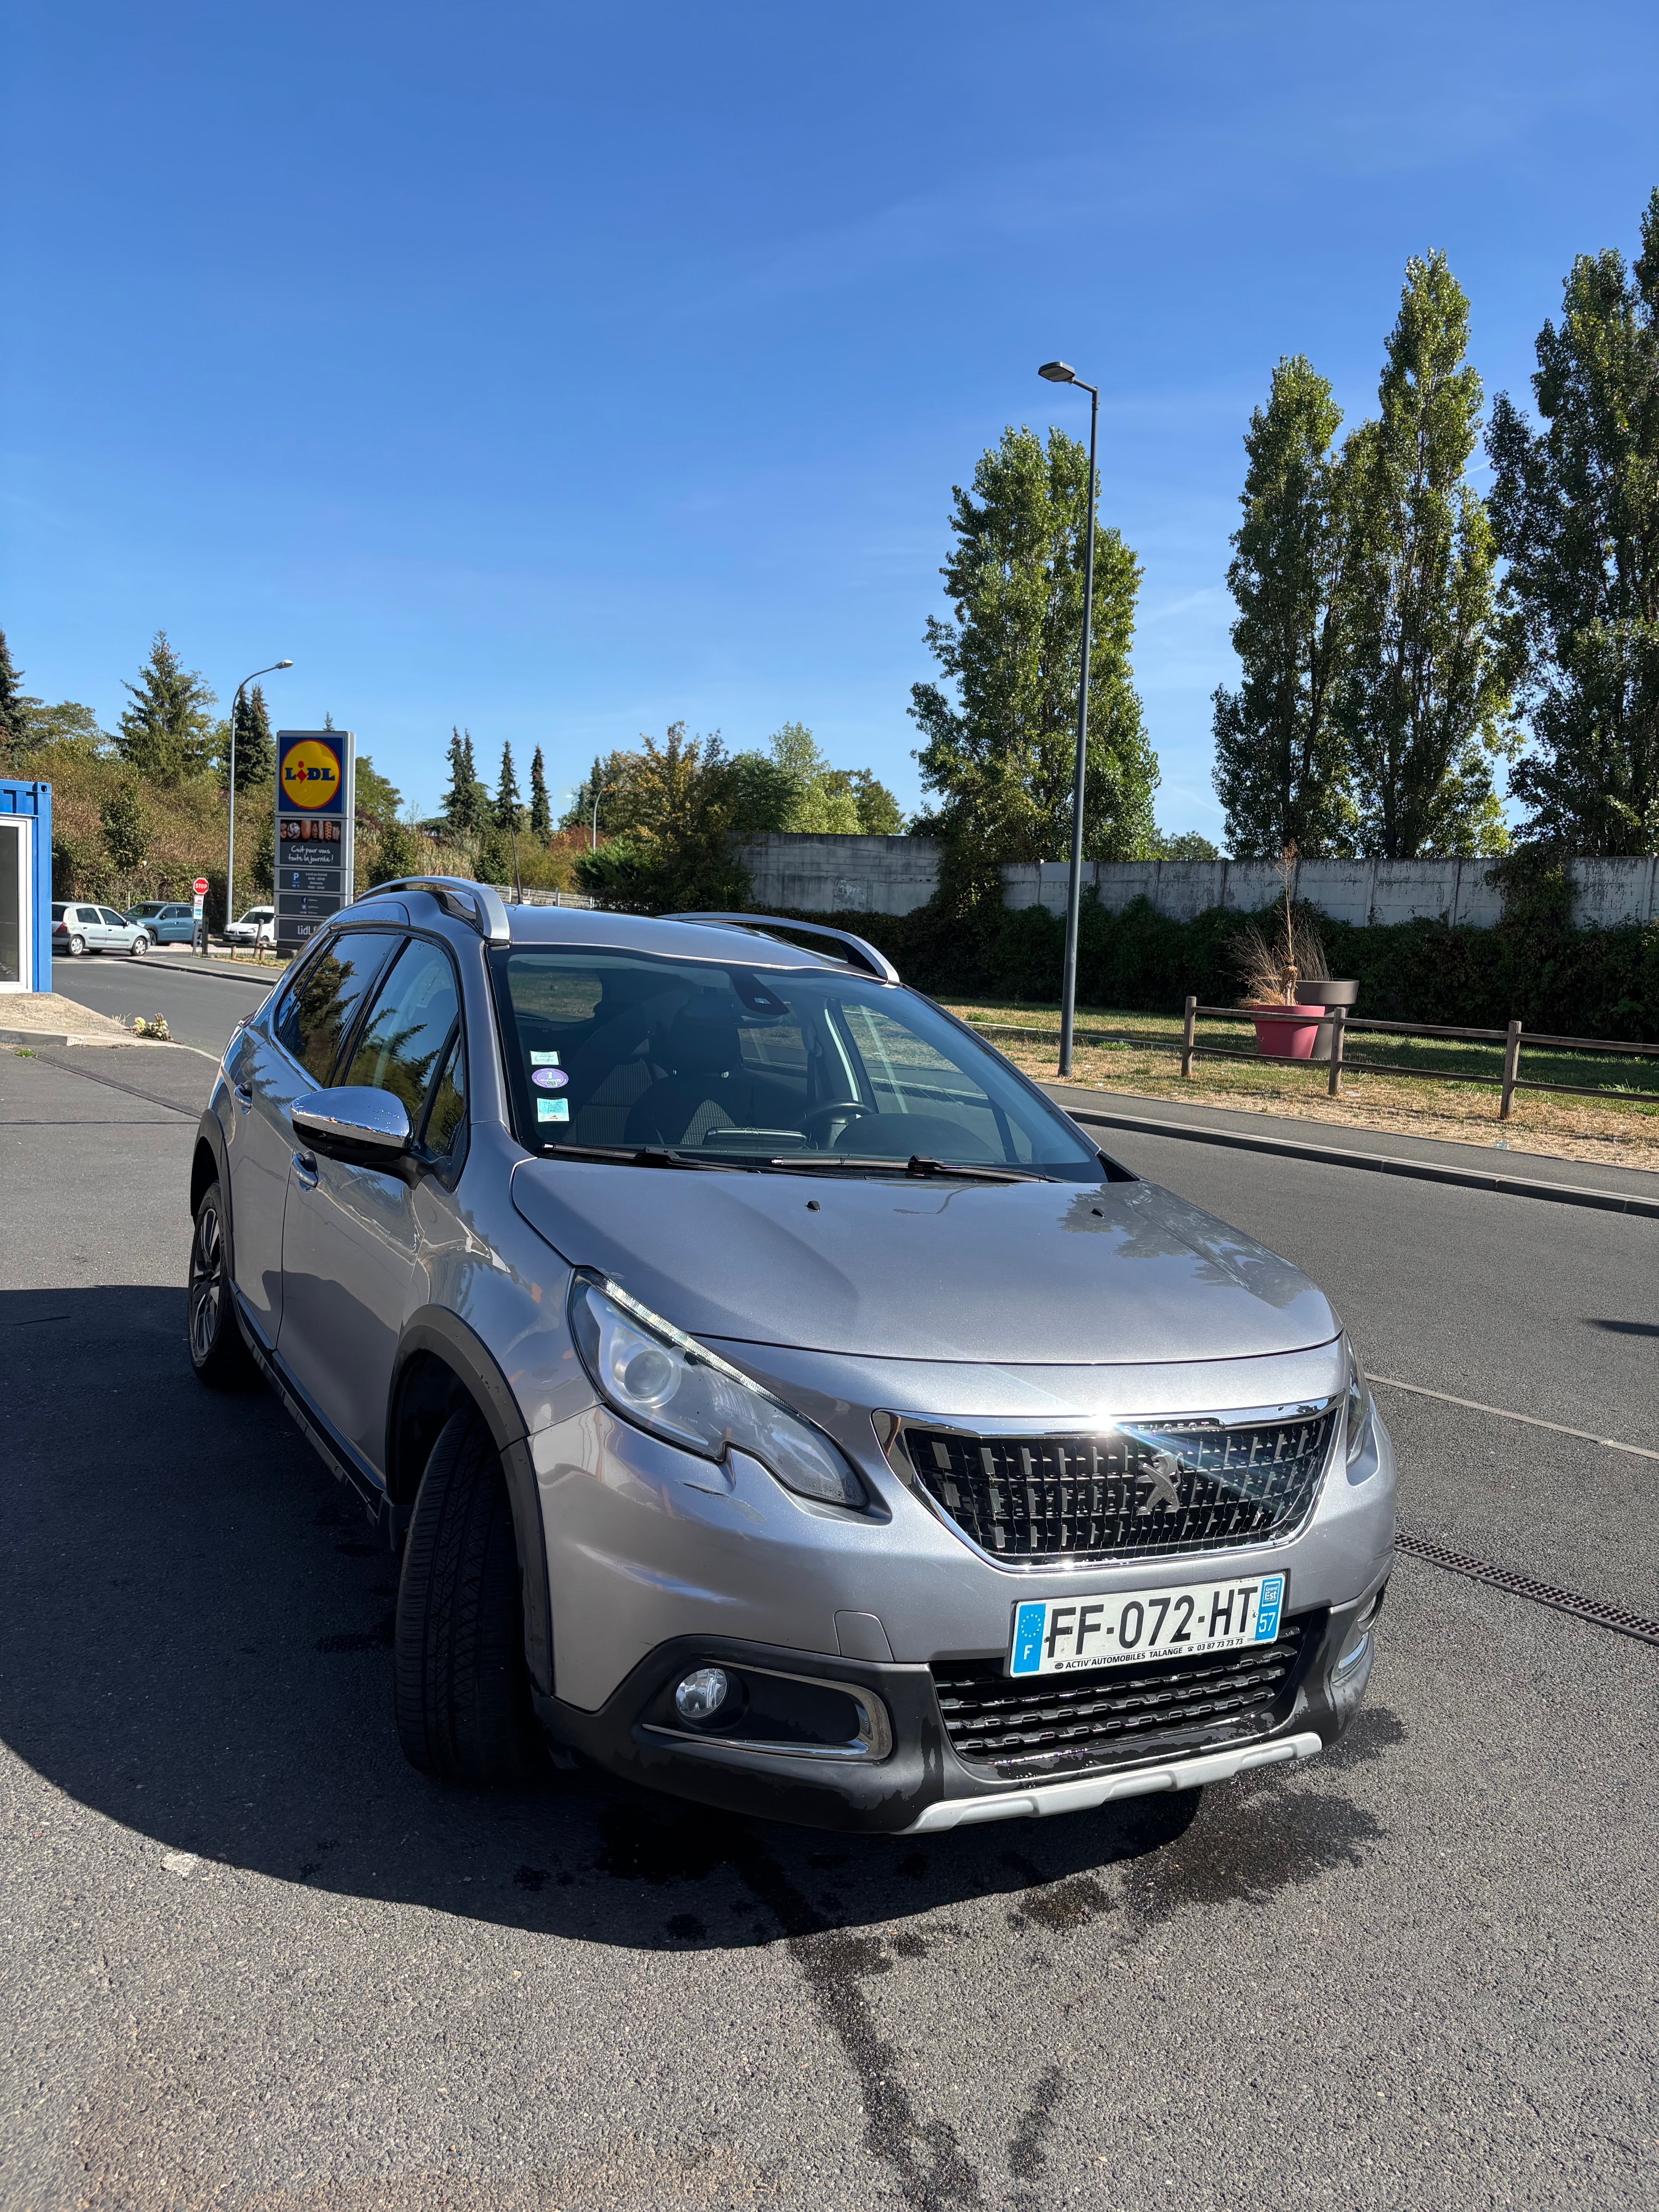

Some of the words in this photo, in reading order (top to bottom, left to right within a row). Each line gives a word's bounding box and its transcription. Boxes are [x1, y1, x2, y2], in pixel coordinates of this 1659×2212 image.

[294, 872, 299, 881] P
[1264, 1591, 1277, 1601] Est
[1259, 1612, 1276, 1633] 57
[1024, 1645, 1033, 1660] F
[1149, 1647, 1183, 1658] TALANGE
